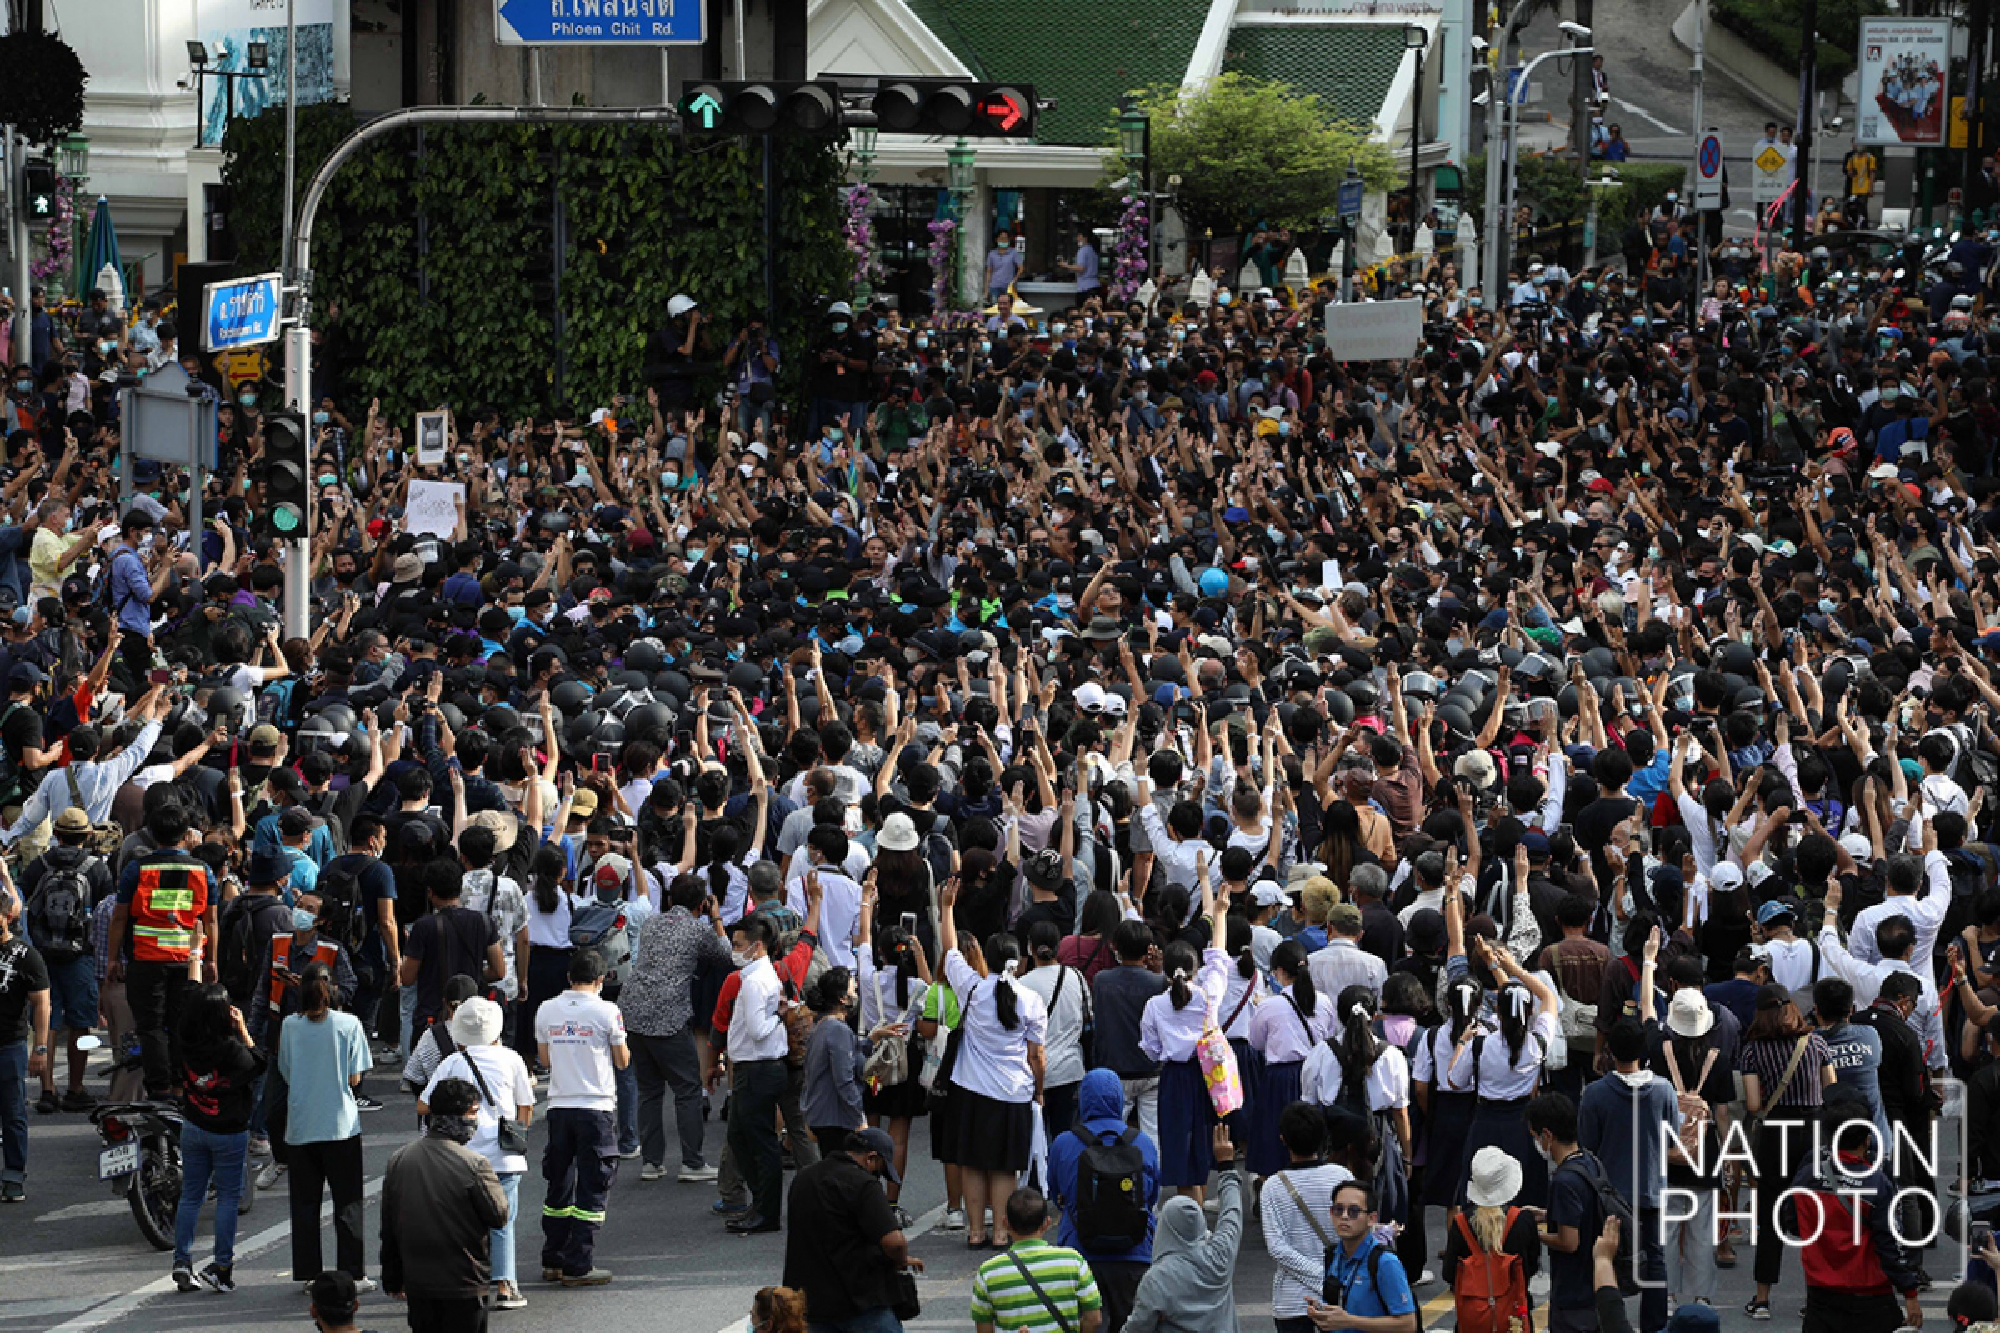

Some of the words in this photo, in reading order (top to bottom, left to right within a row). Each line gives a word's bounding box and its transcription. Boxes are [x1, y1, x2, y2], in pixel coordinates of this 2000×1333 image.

[551, 22, 603, 36] Phloen
[611, 22, 641, 36] Chit
[652, 22, 675, 36] Rd.
